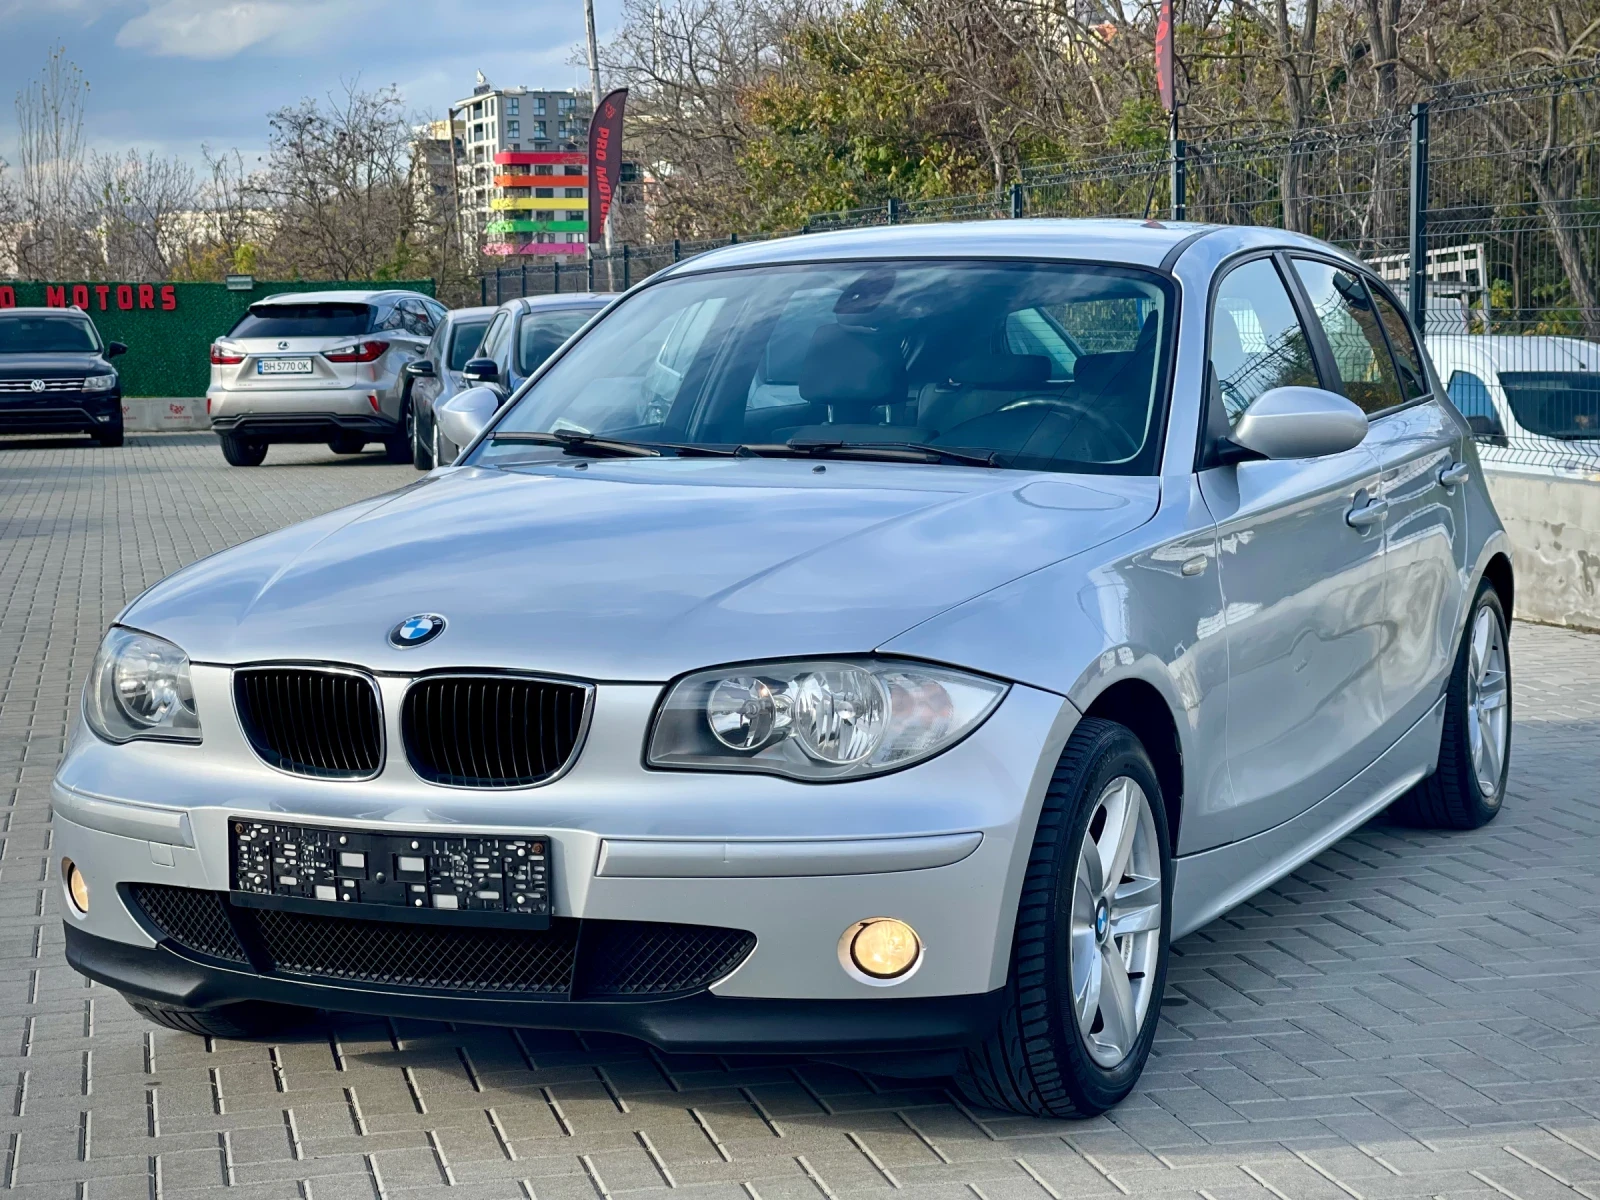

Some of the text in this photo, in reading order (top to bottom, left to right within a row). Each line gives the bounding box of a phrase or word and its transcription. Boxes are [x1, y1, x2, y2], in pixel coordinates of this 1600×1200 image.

[596, 127, 609, 161] PRO
[47, 285, 176, 310] MOTORS
[263, 361, 309, 371] BH 5770 OK
